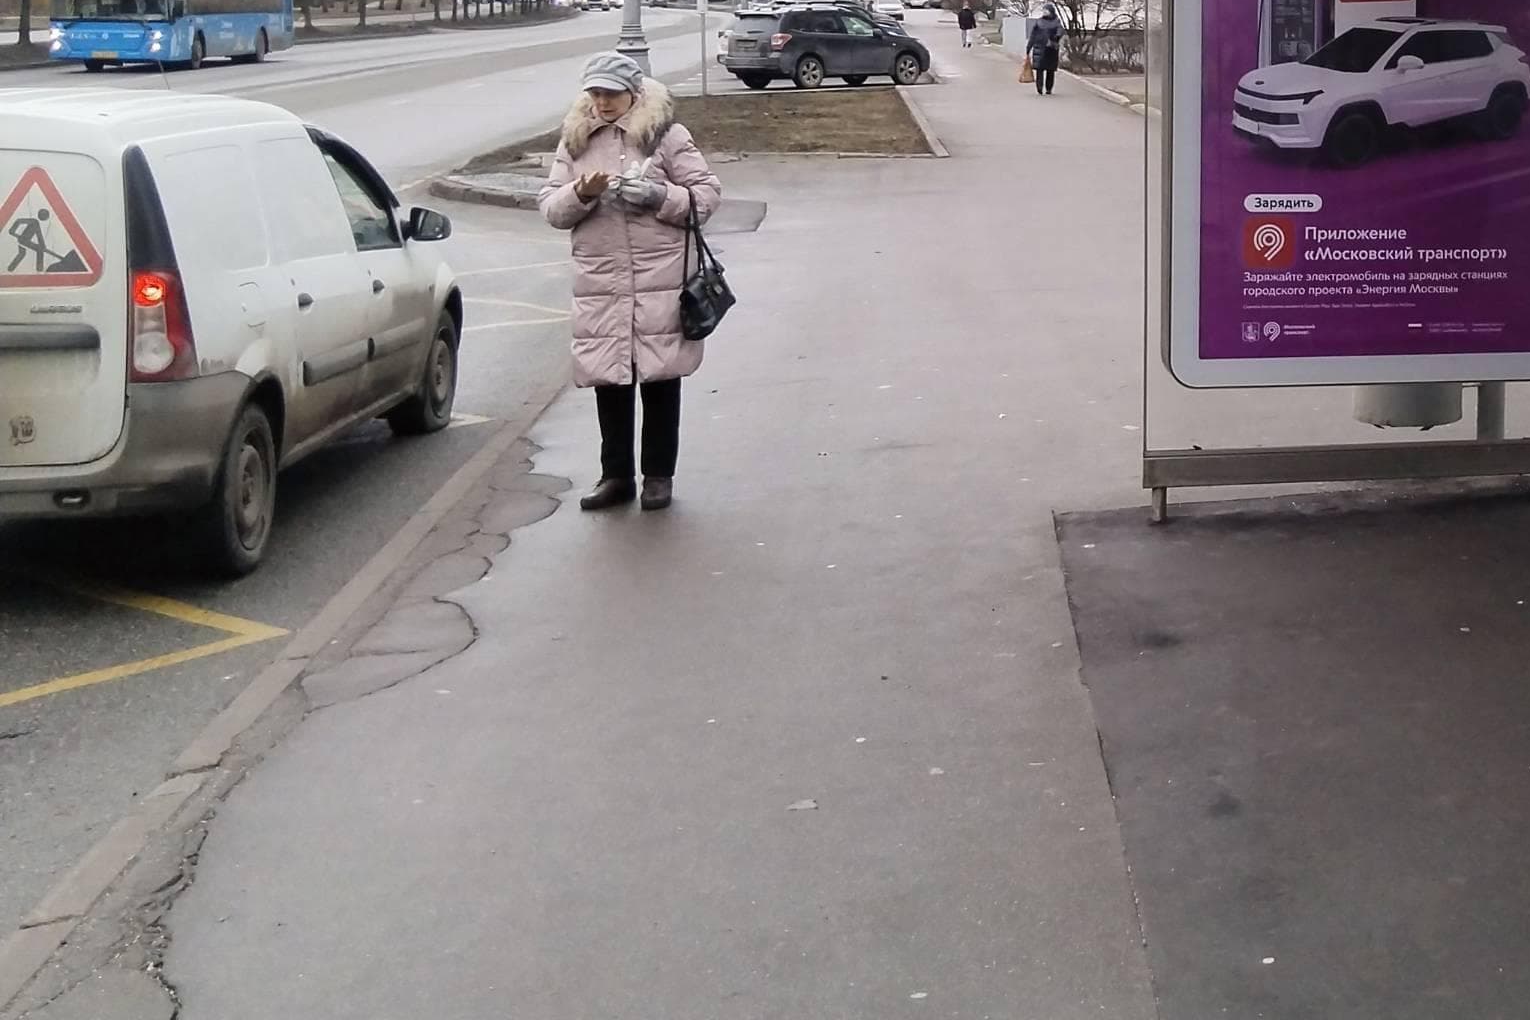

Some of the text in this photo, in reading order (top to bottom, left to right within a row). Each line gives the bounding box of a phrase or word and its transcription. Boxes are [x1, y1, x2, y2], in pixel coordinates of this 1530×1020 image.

[1254, 197, 1314, 210] Зарядить
[1304, 226, 1407, 243] Приложение
[1304, 246, 1507, 262] «Московский транспорт»
[1243, 270, 1508, 283] Заряжайте электромобиль на зарядных станциях
[1243, 286, 1306, 297] городского
[1308, 285, 1353, 297] проекта
